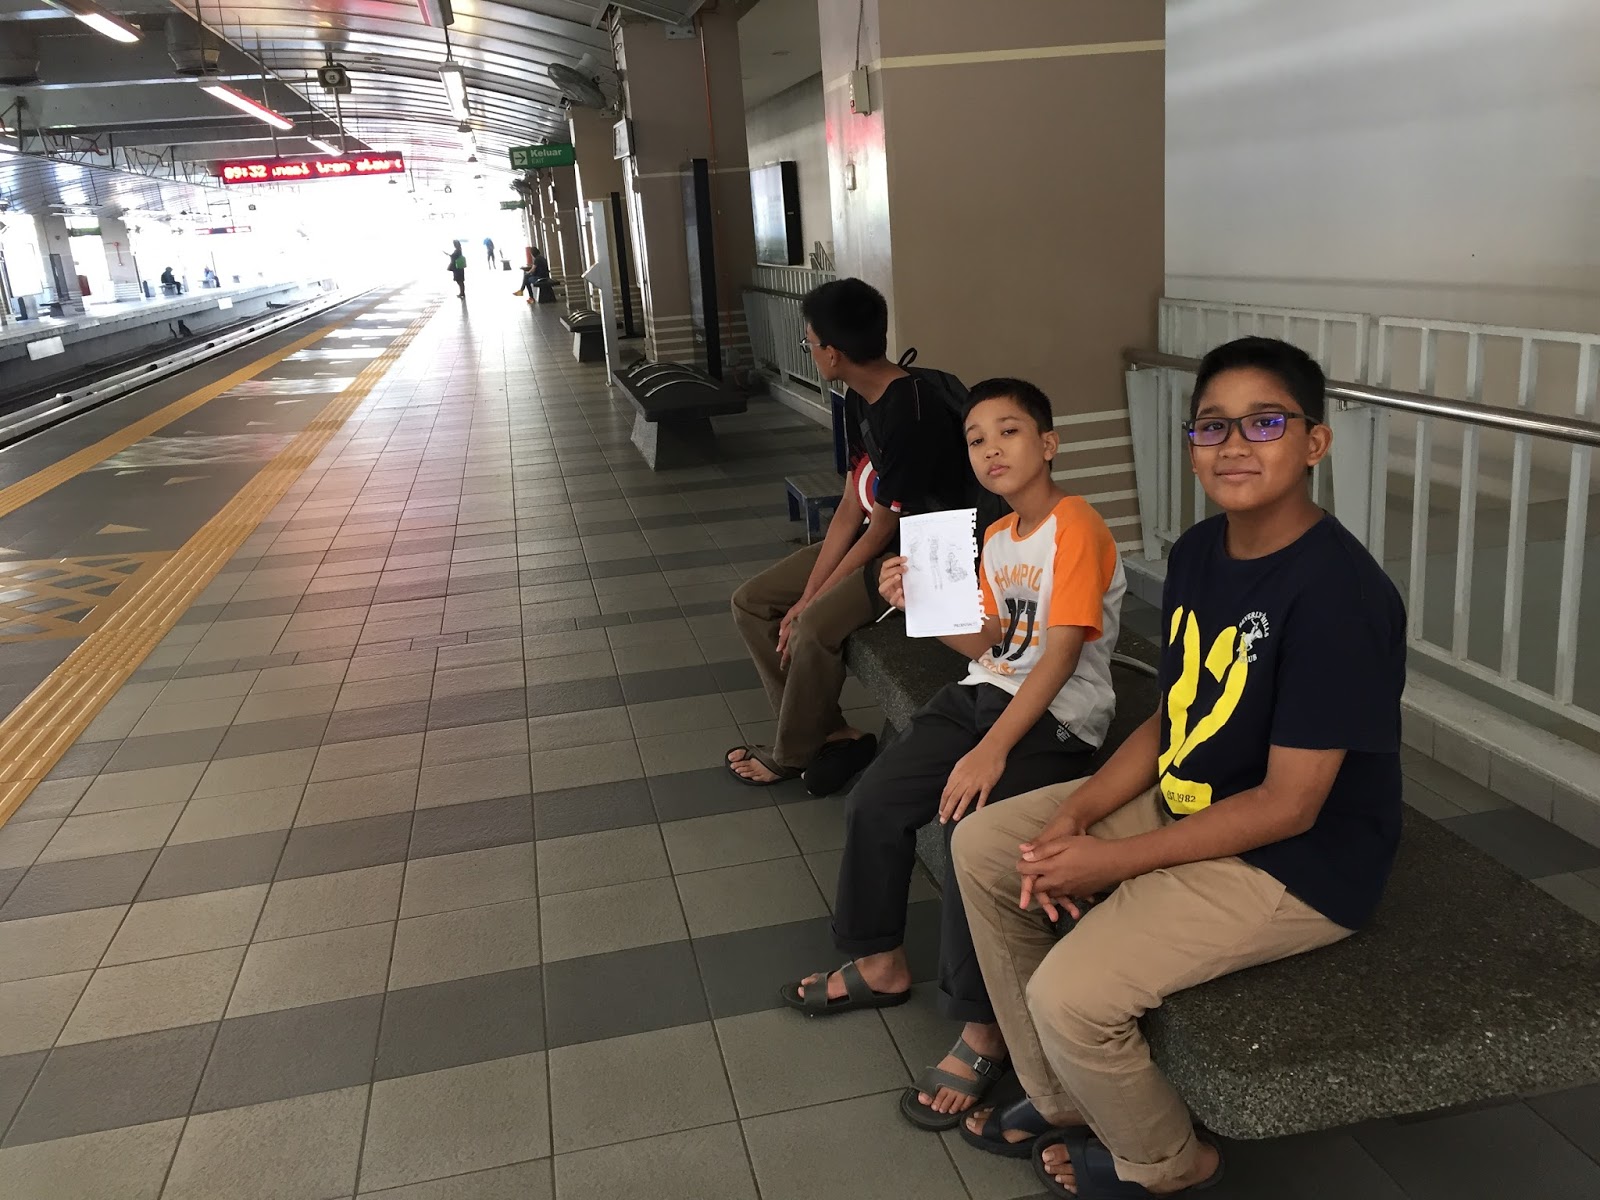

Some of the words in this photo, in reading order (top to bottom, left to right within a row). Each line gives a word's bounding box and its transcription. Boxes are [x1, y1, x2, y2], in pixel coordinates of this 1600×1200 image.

[530, 149, 562, 158] Keluar
[223, 165, 267, 179] 09:32
[1238, 611, 1263, 628] BEVERLY
[1260, 612, 1270, 638] HILLS
